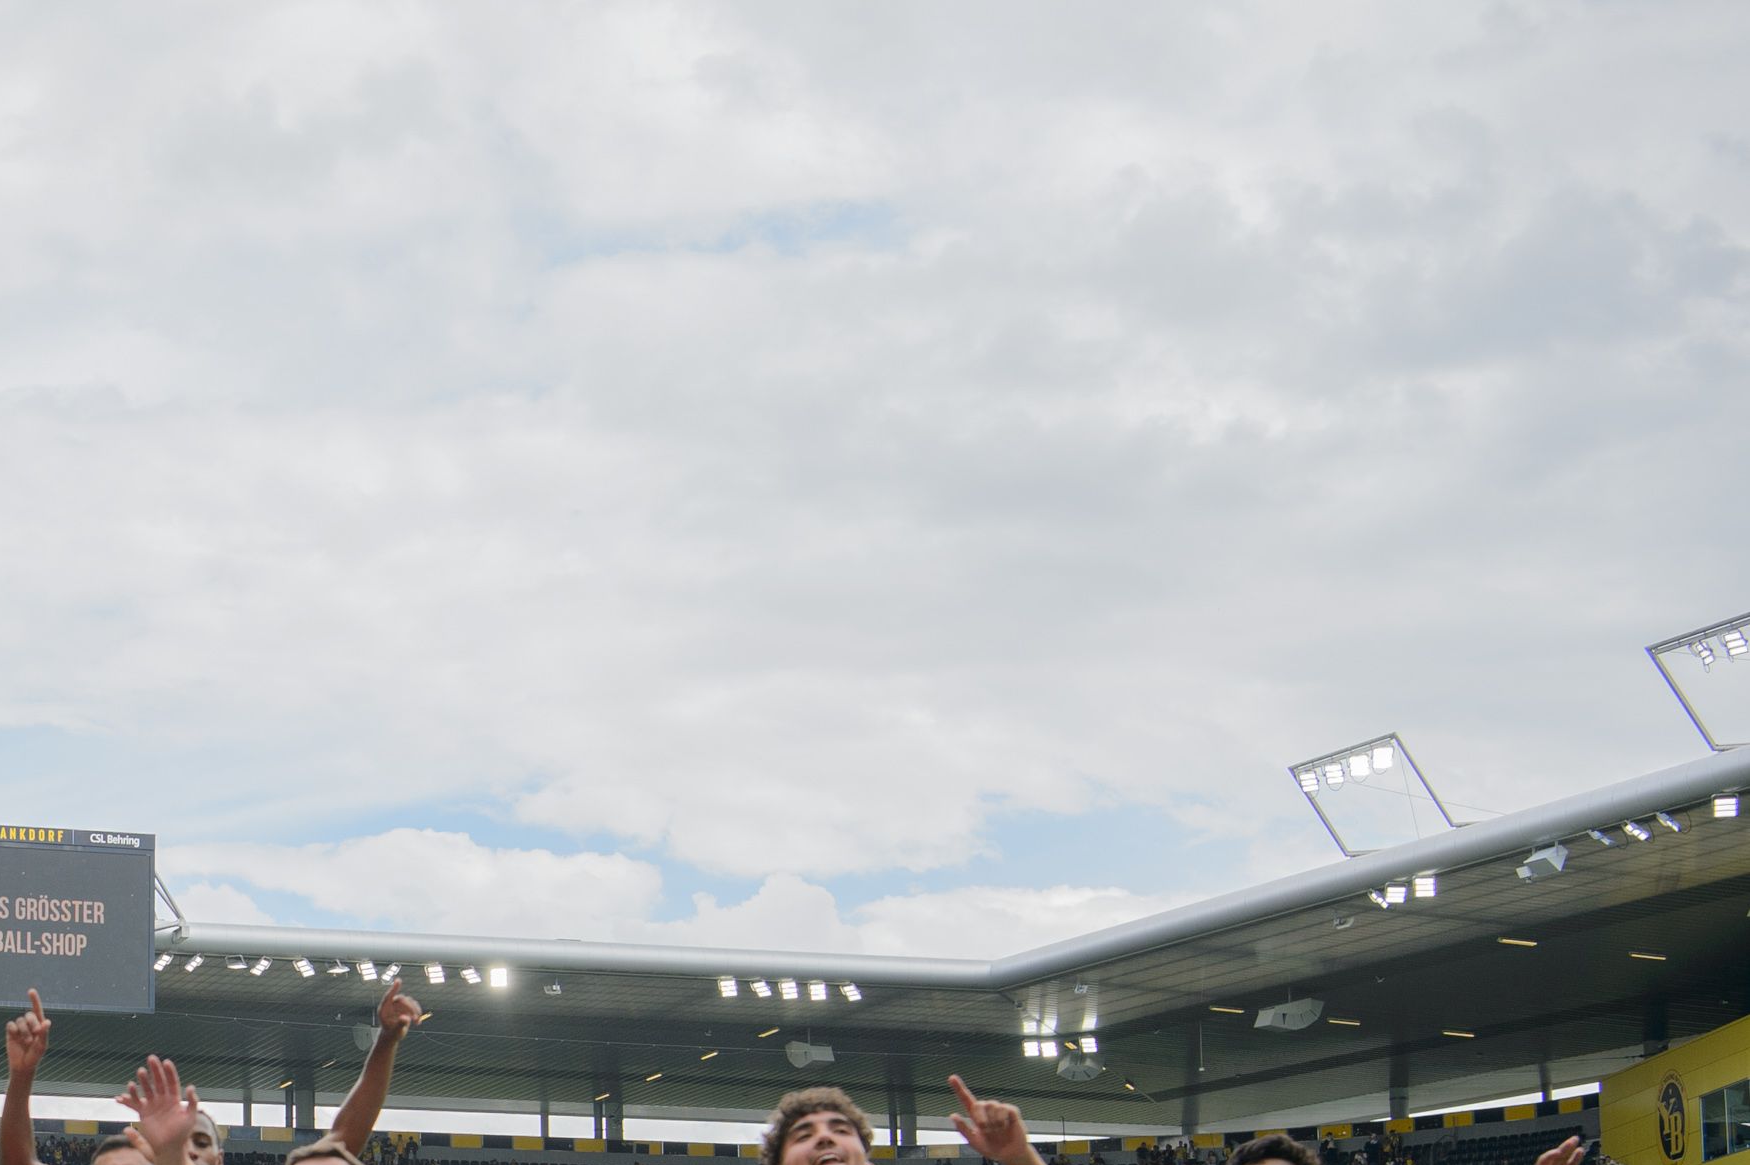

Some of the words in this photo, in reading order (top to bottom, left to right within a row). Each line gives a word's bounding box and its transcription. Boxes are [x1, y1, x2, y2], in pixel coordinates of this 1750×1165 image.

[90, 833, 106, 844] CSL
[107, 834, 140, 848] Behring
[15, 894, 105, 925] GRÖSSTER
